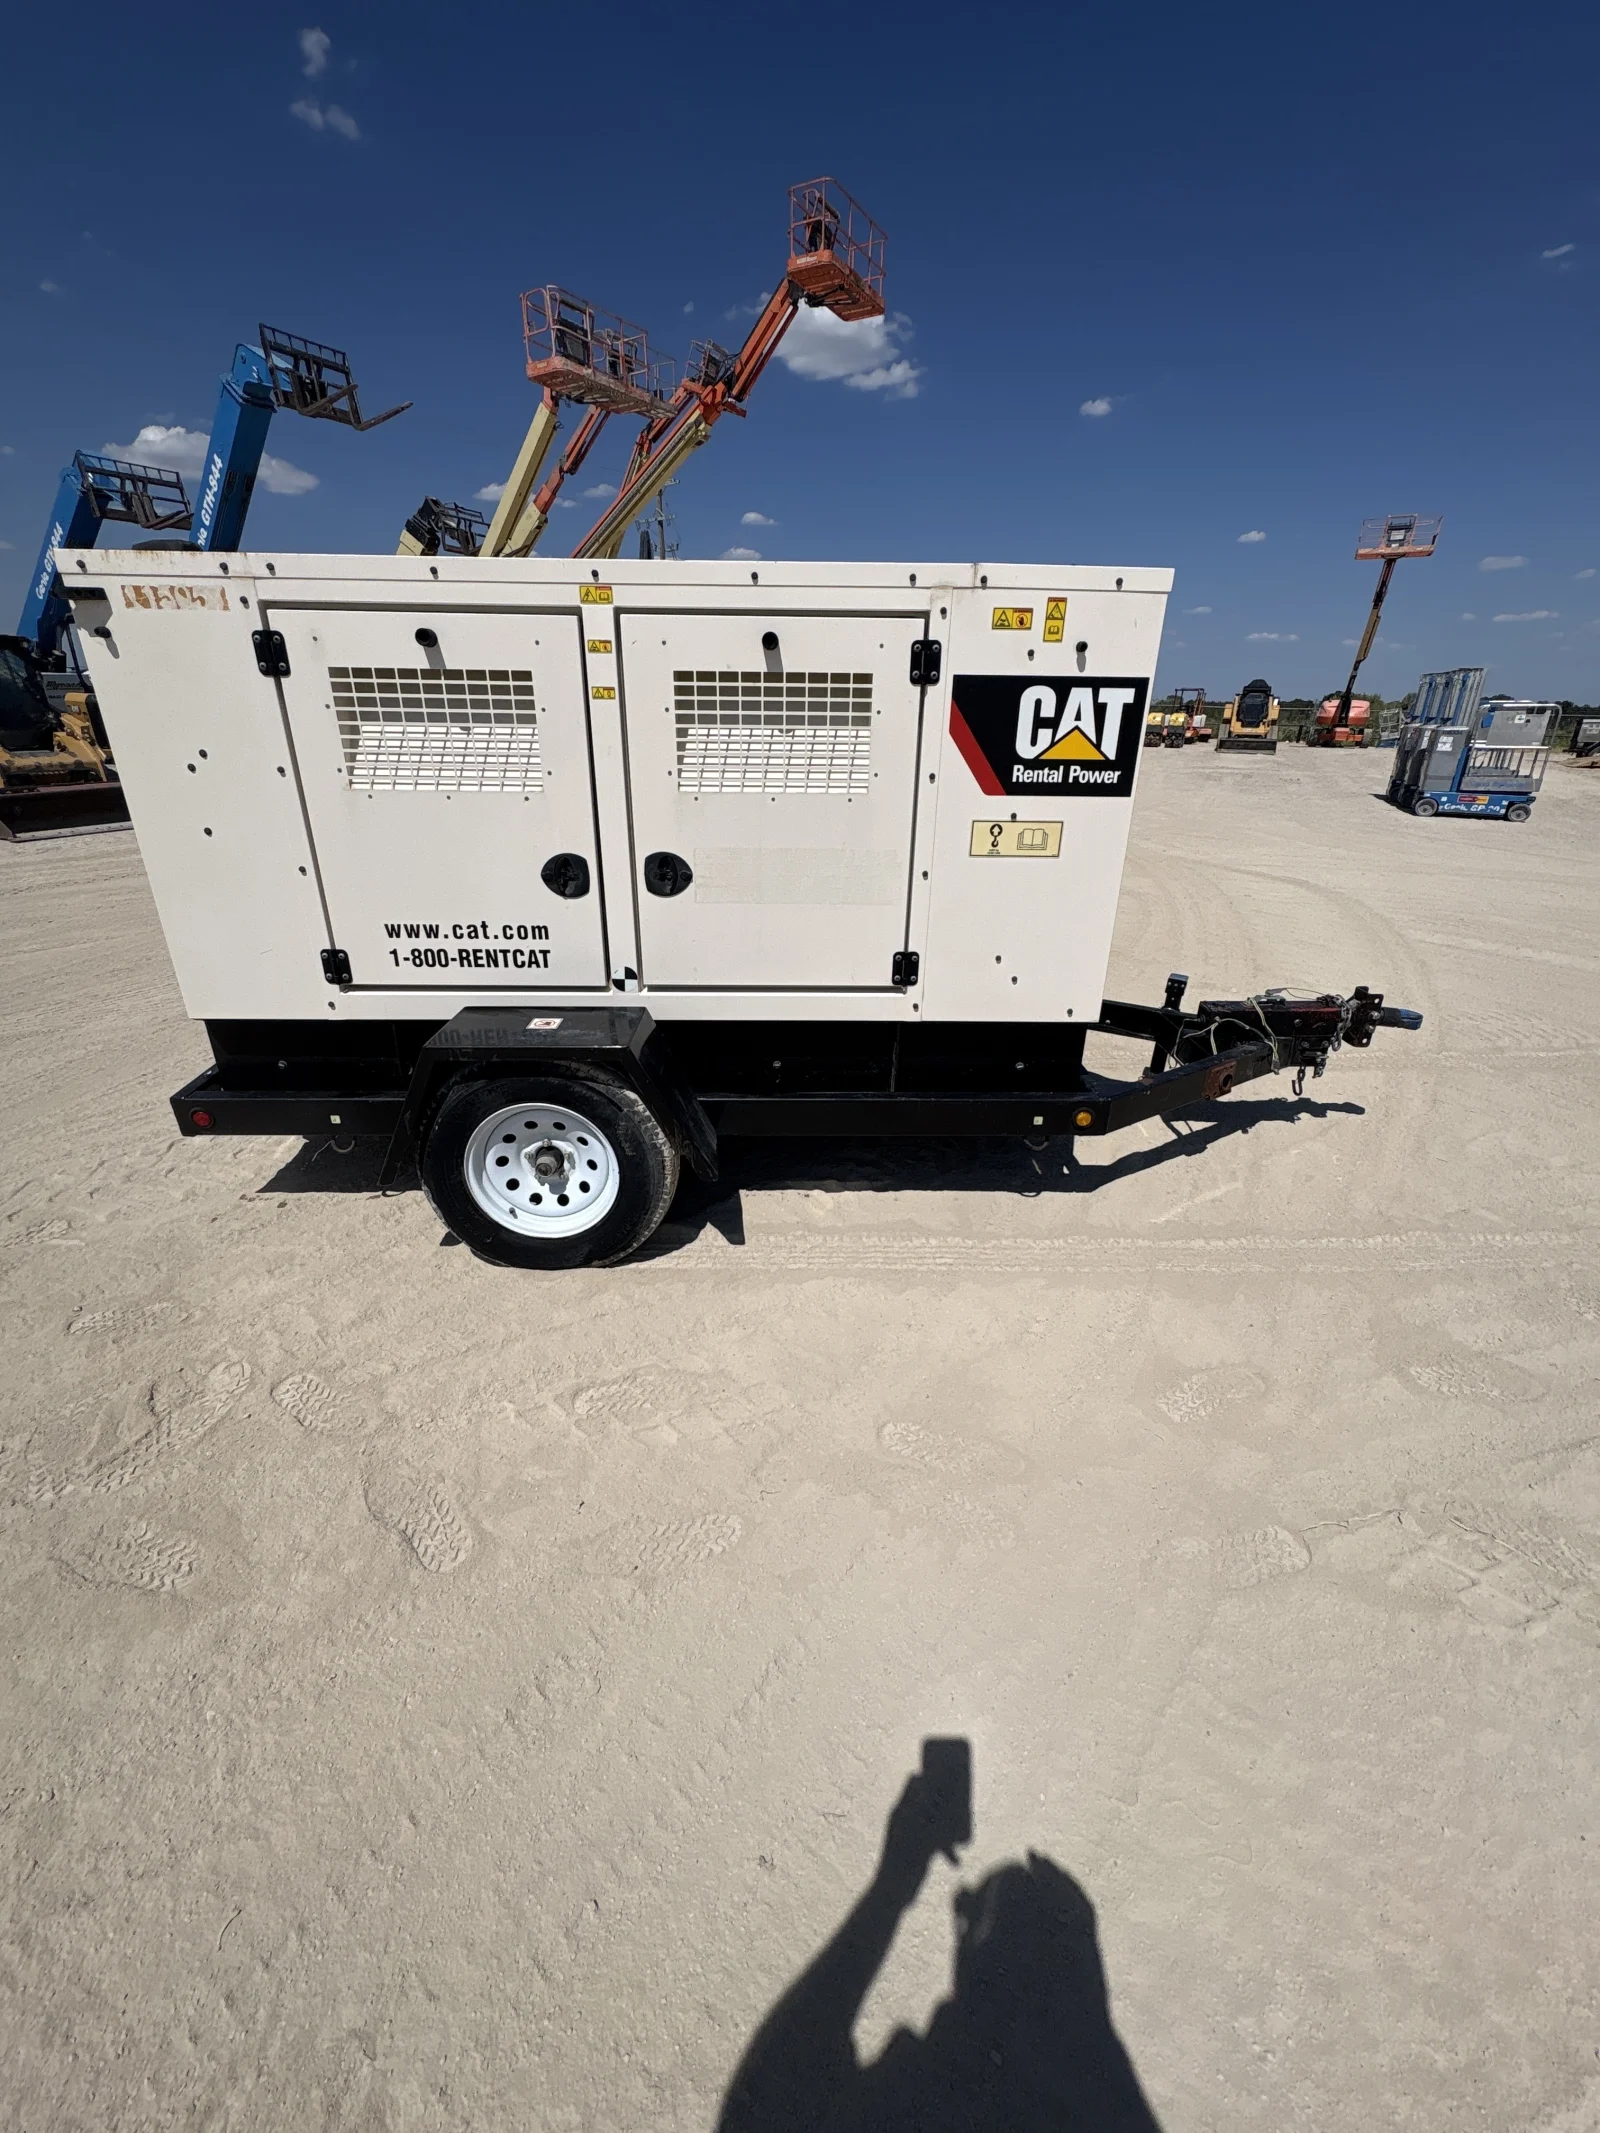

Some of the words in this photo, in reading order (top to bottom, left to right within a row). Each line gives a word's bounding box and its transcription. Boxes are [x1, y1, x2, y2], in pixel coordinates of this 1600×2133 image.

[201, 453, 223, 526] GTH-844
[197, 527, 208, 546] nie
[36, 571, 50, 599] Genie
[1015, 685, 1135, 760] CAT
[1012, 764, 1064, 783] Rental
[1068, 765, 1121, 784] Power
[384, 921, 550, 940] www.cat.com
[389, 948, 551, 968] 1-800-RENTCAT
